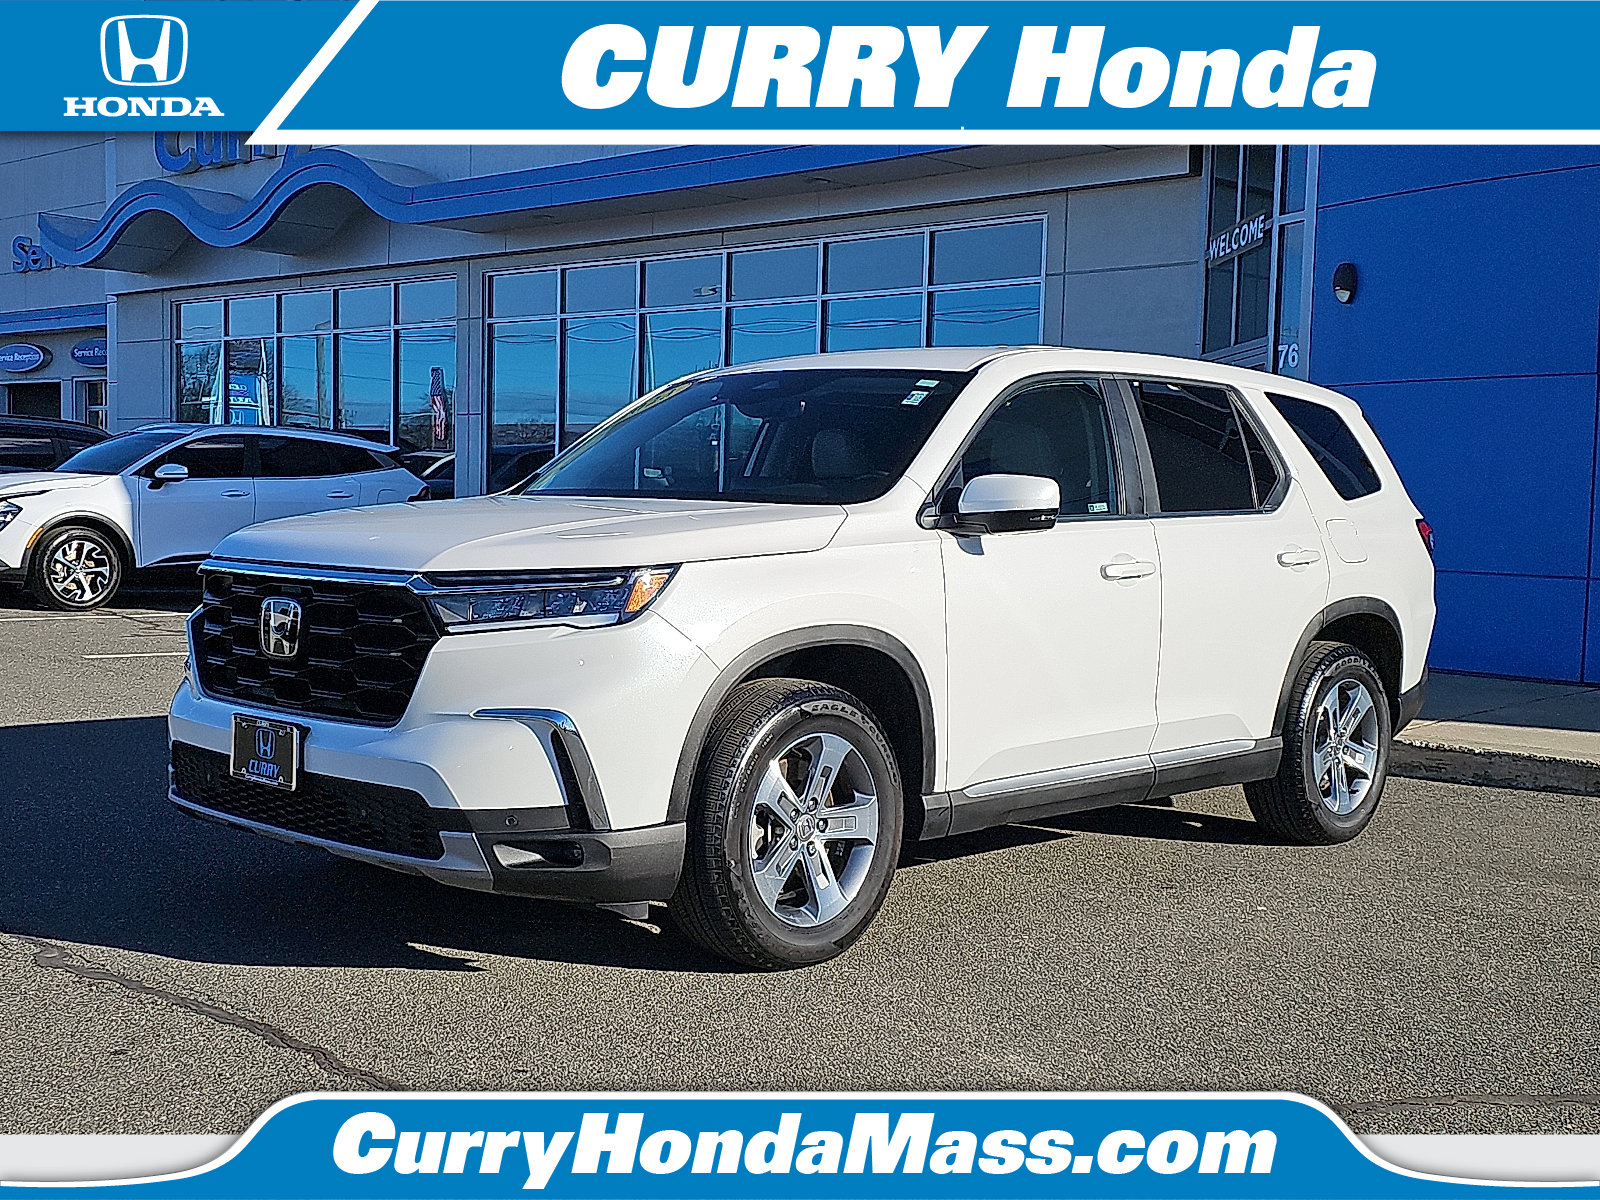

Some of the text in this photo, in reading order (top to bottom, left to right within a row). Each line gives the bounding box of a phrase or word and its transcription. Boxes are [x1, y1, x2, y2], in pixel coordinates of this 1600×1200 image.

[1209, 214, 1266, 261] WELCOME
[1278, 343, 1299, 369] 76
[811, 703, 859, 718] EAGLE
[248, 759, 280, 778] CURRY
